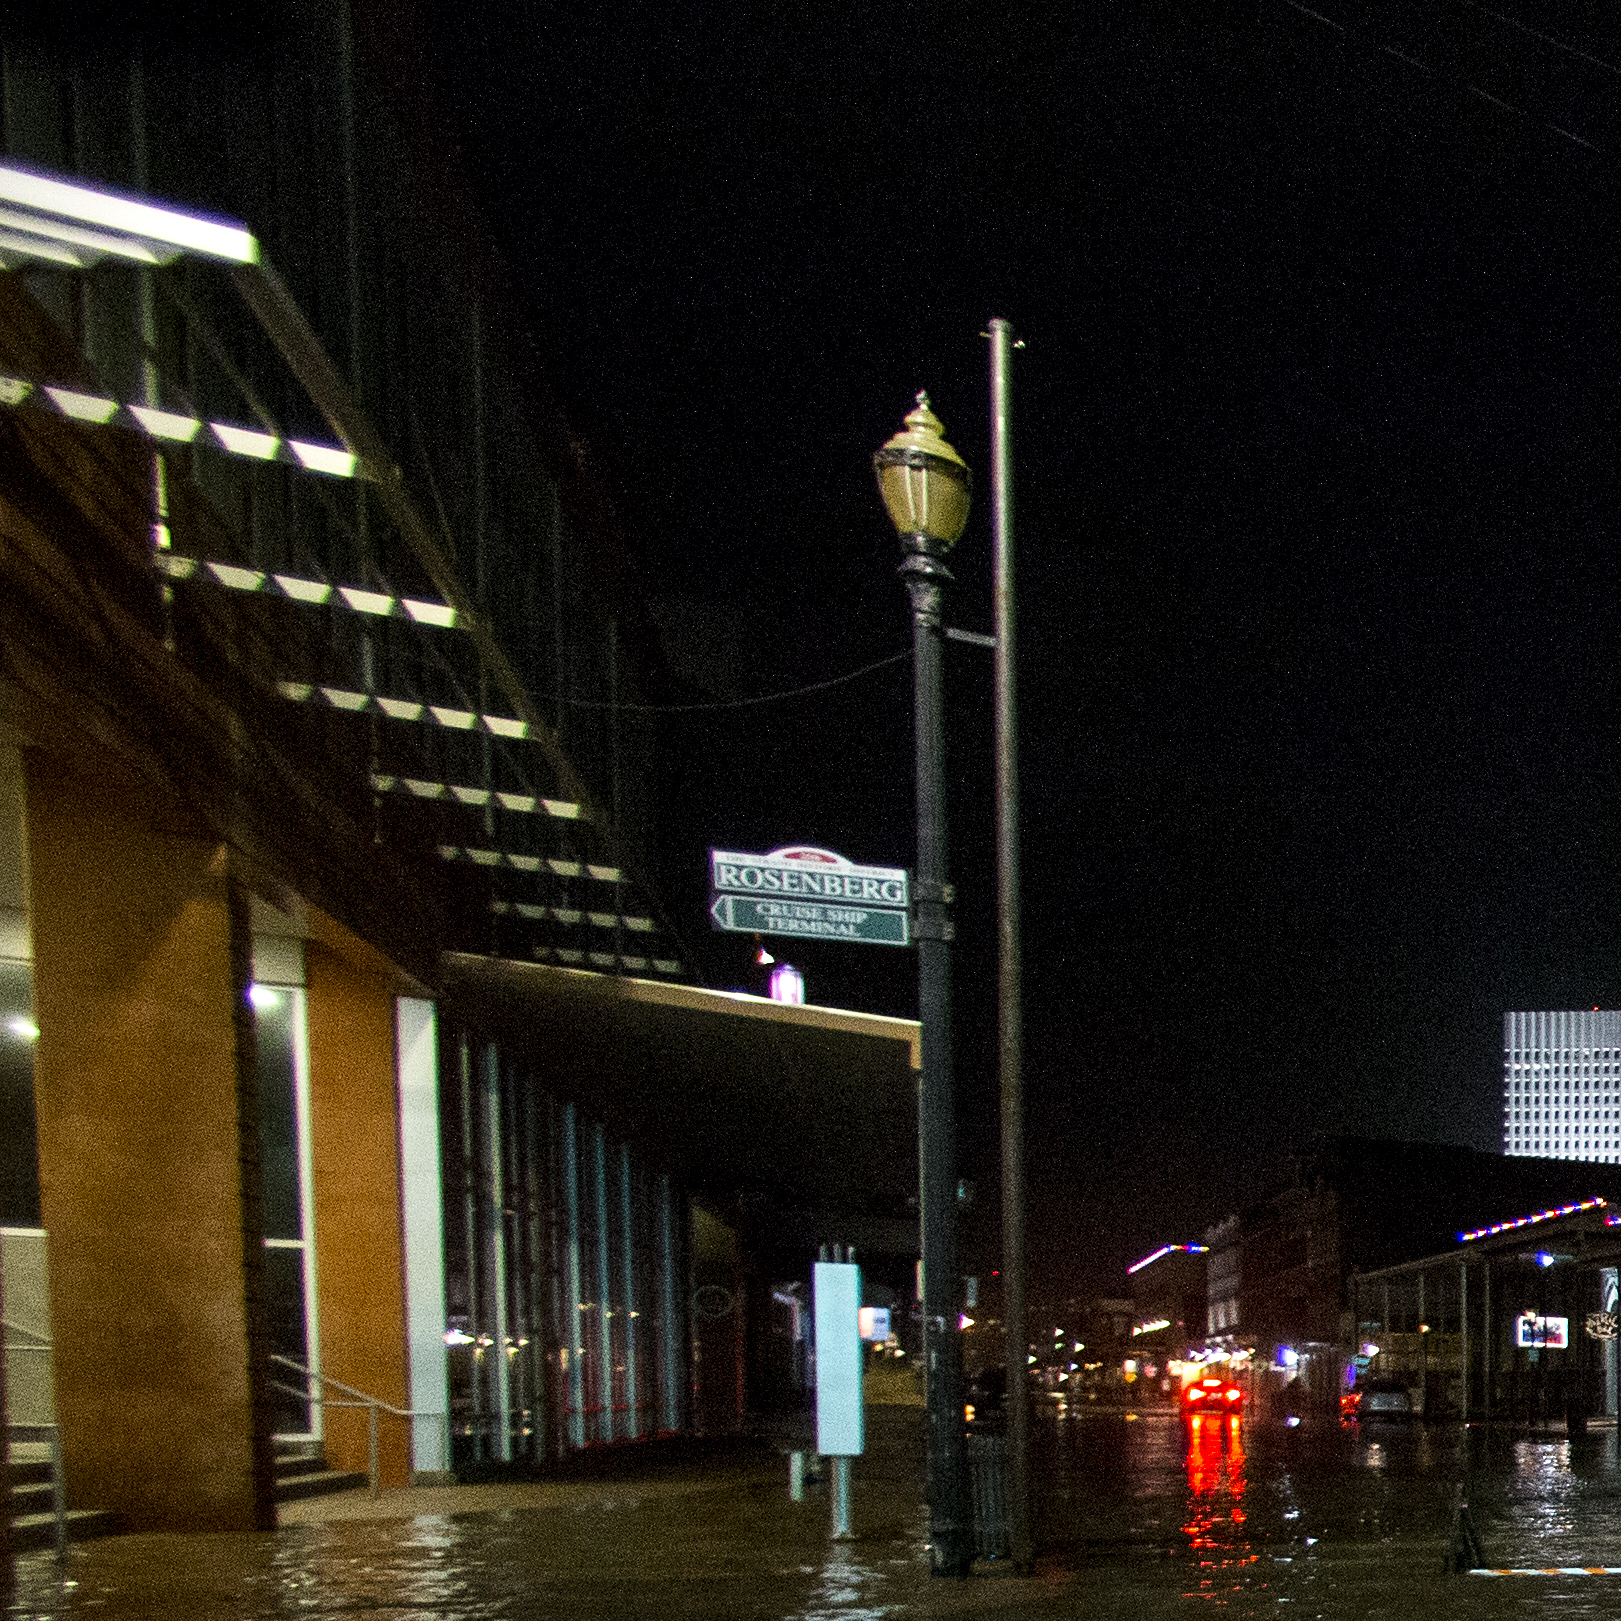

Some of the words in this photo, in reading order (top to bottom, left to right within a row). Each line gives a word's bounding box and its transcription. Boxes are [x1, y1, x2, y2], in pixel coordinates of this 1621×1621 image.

[720, 864, 902, 902] ROSENBERG
[755, 903, 822, 918] CRUISE
[826, 908, 868, 923] SHIP
[766, 917, 860, 937] TERMINAL
